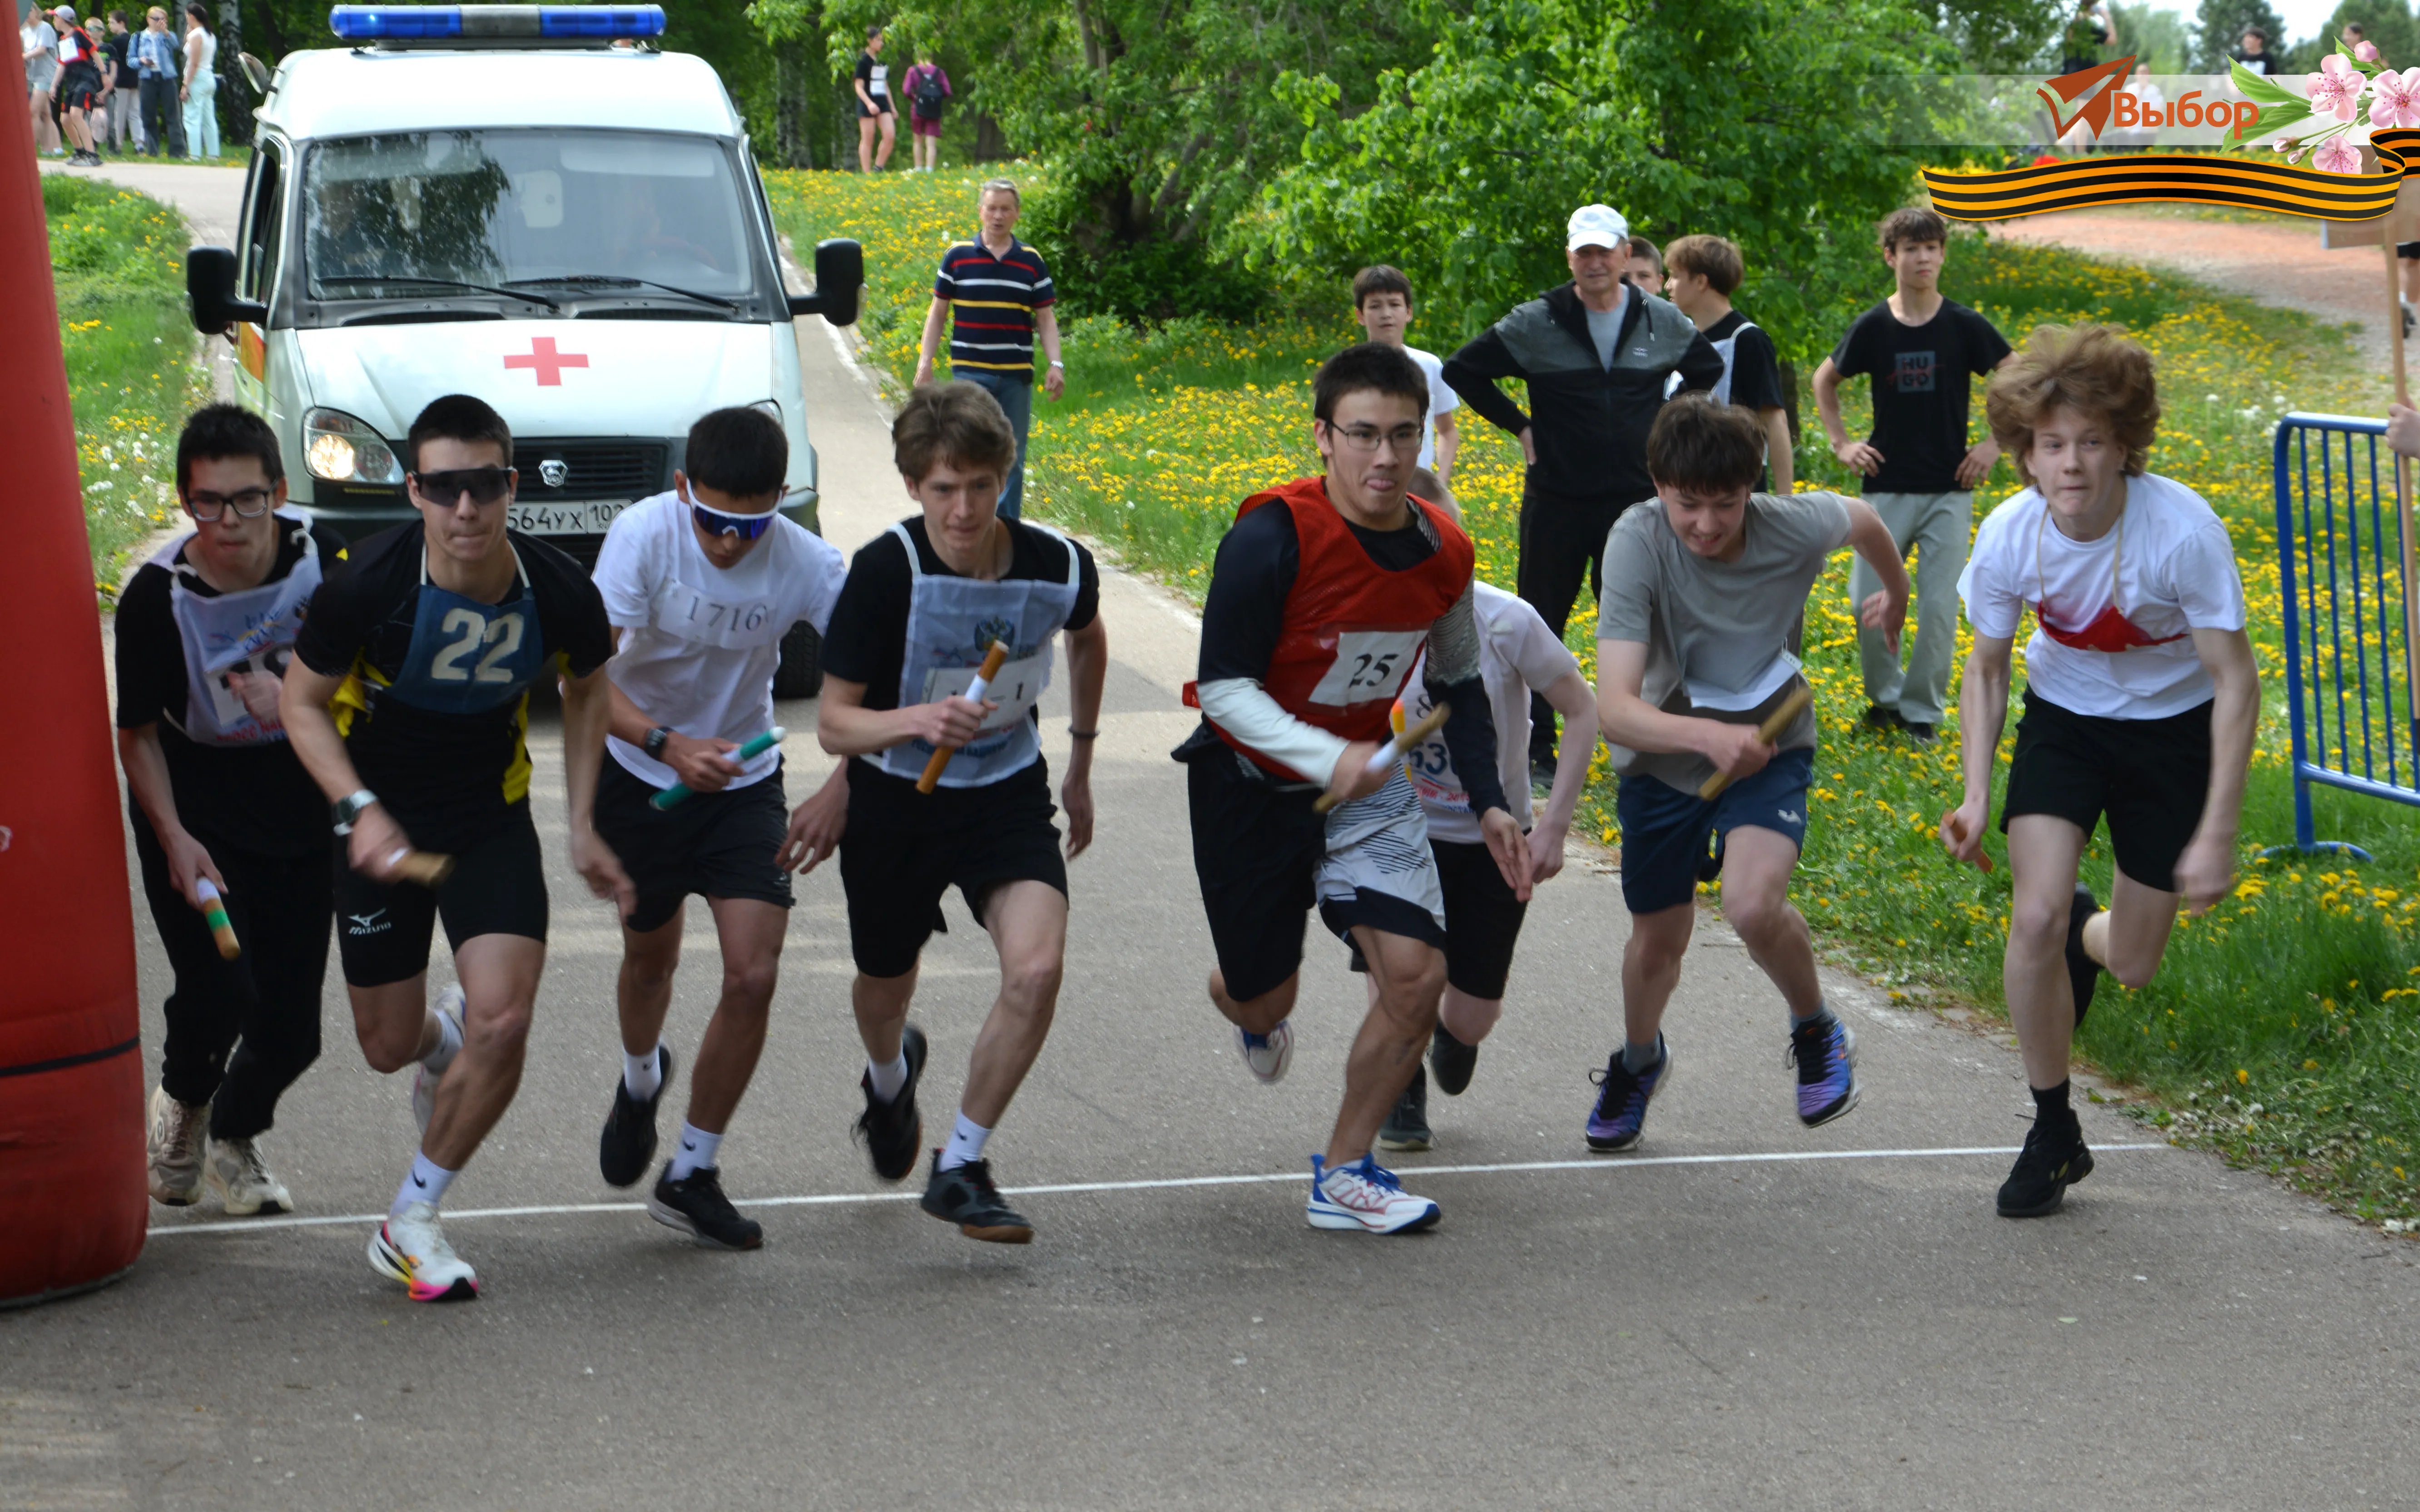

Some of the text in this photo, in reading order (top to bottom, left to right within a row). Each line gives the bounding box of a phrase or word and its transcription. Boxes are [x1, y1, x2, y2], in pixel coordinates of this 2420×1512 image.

[1903, 372, 1930, 387] GO
[687, 596, 769, 632] 1716
[431, 608, 525, 683] 22
[1348, 653, 1399, 689] 25
